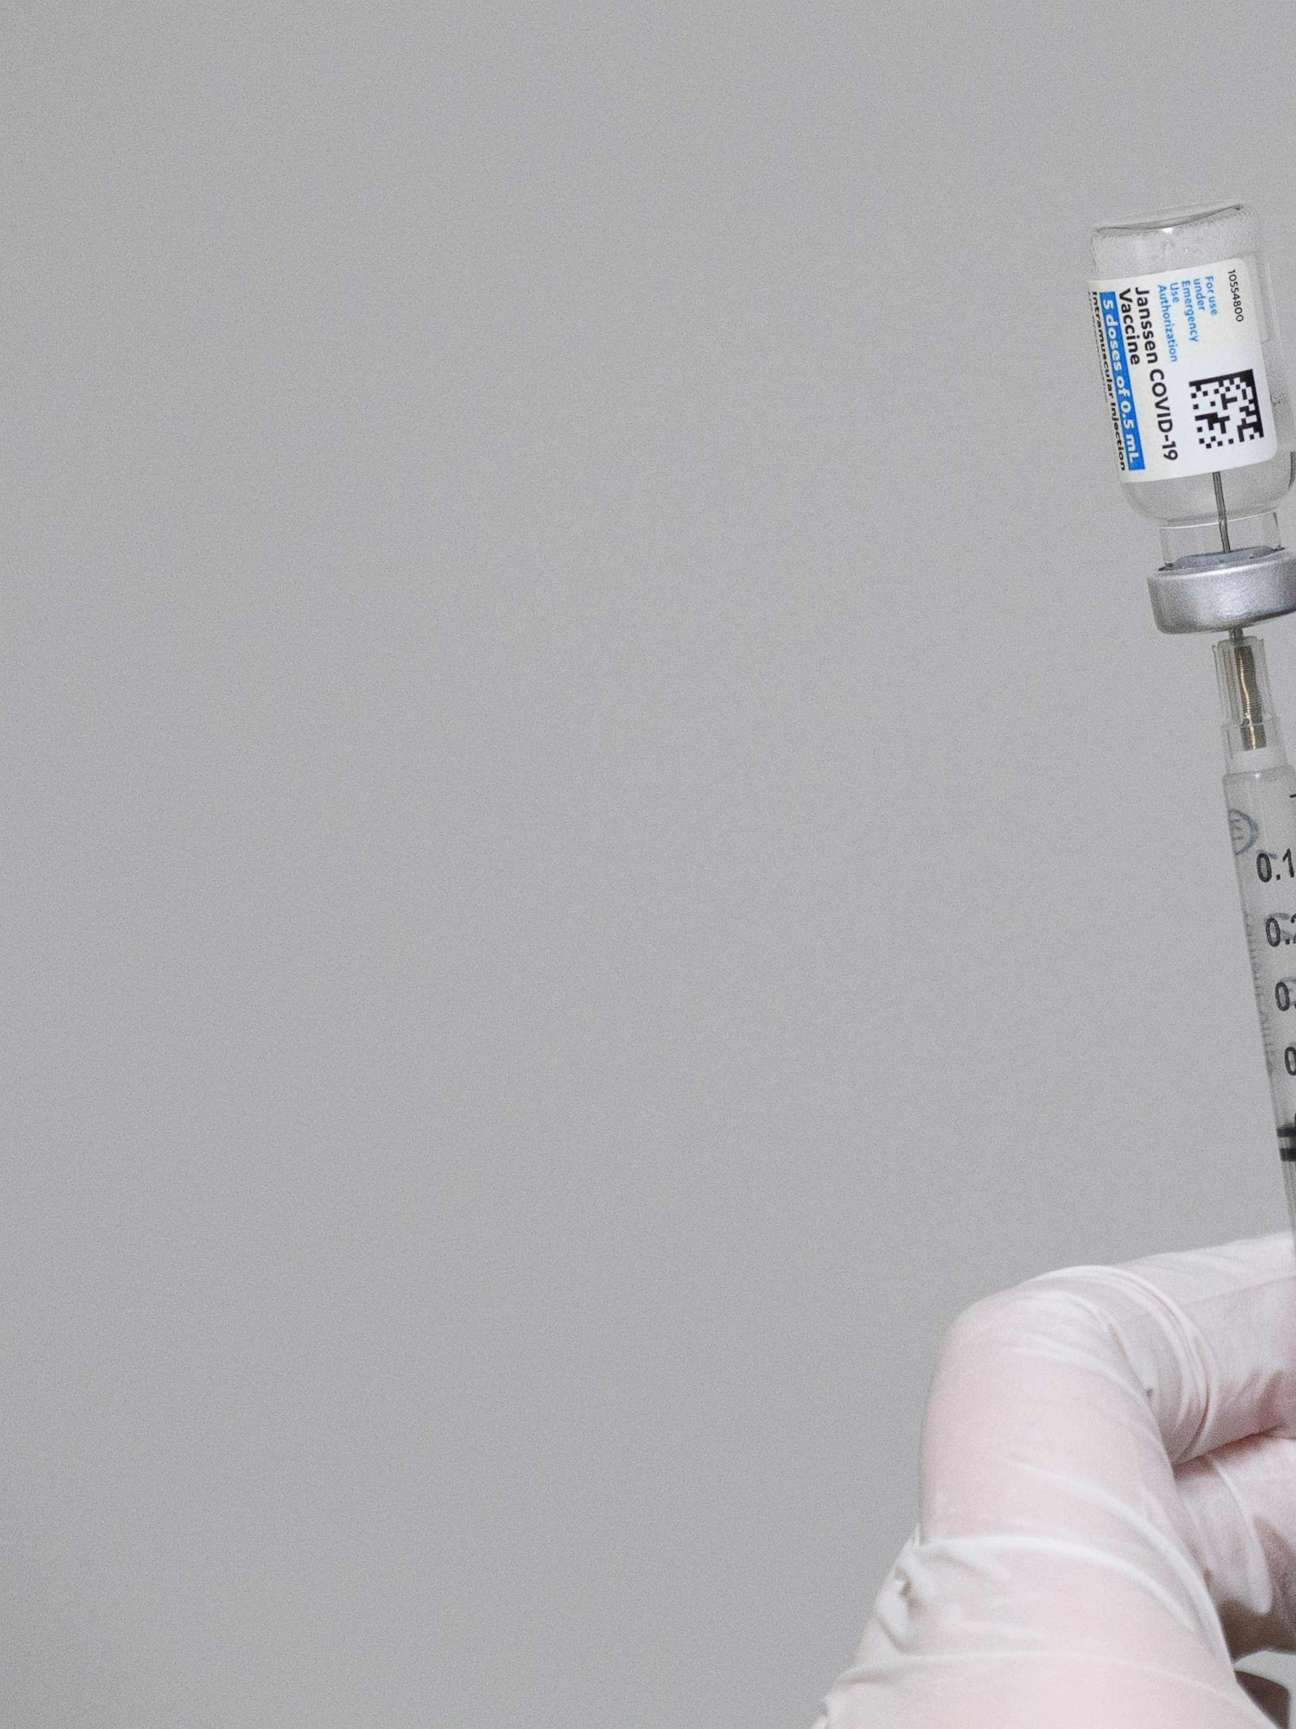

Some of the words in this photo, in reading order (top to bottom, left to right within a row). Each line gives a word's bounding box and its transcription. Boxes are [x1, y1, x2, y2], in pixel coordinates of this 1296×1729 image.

[1170, 283, 1180, 303] Use
[1193, 278, 1206, 310] under
[1205, 276, 1214, 293] For
[1228, 270, 1244, 322] 10554800
[1103, 299, 1113, 309] 5
[1182, 280, 1199, 342] Emergency
[1208, 296, 1218, 315] use
[1119, 288, 1140, 365] Vaccine
[1157, 285, 1179, 362] Authorization
[1105, 315, 1121, 370] doses
[1092, 291, 1114, 398] Intramuscular
[1110, 403, 1125, 471] Injection
[1116, 376, 1129, 396] of
[1135, 287, 1159, 364] Janssen
[1149, 369, 1178, 461] COVID-19
[1121, 401, 1136, 429] 0.5
[1125, 433, 1139, 463] mL
[1256, 849, 1295, 882] 0.1
